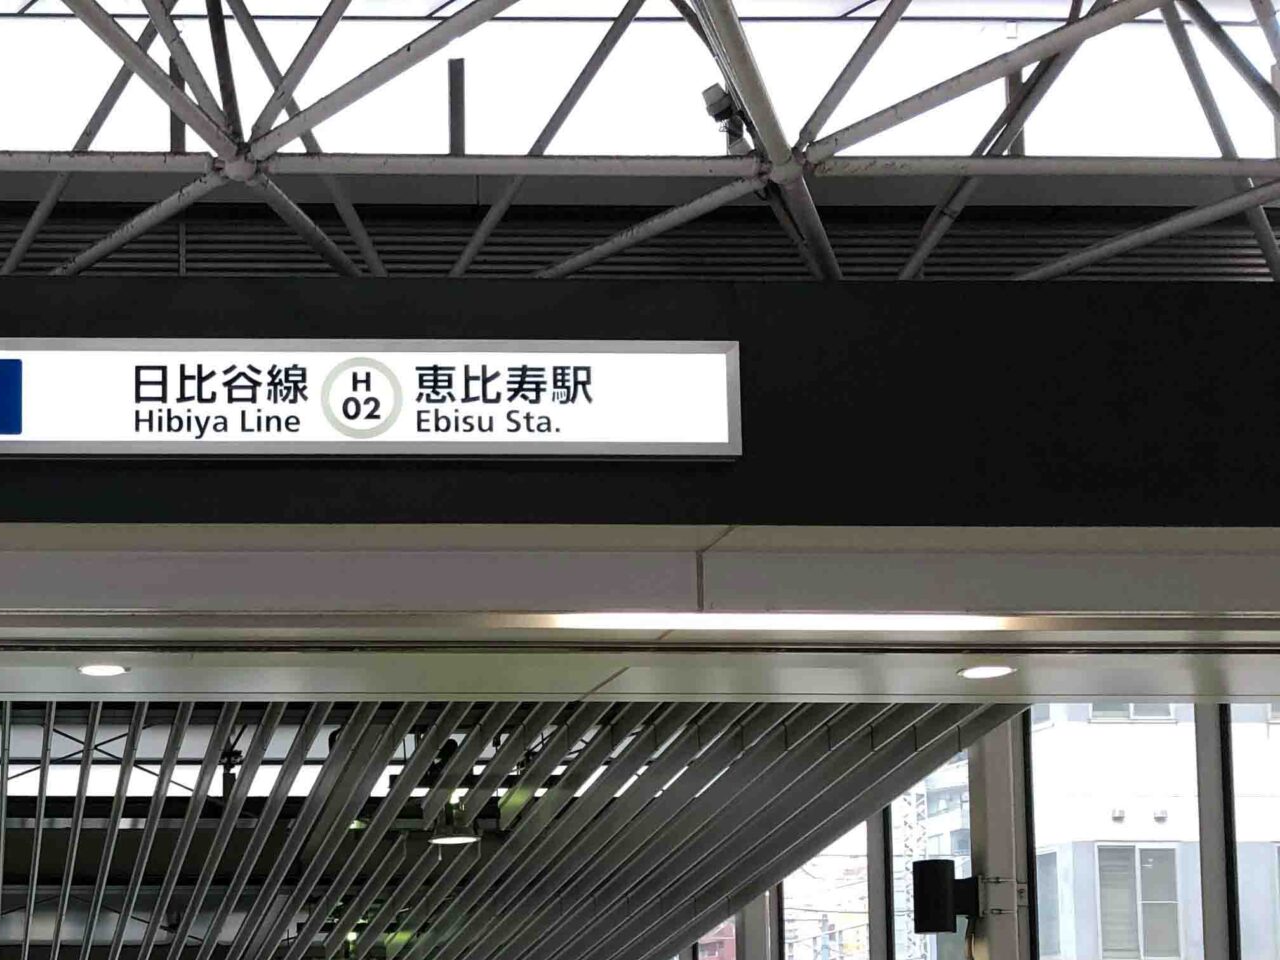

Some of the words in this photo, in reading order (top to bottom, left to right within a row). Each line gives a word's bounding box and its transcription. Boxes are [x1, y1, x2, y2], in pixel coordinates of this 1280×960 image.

[134, 363, 309, 404] 日比谷線
[352, 371, 372, 392] H
[415, 364, 593, 404] 恵比寿駅
[342, 396, 381, 420] 02
[416, 408, 494, 433] Ebisu
[506, 409, 561, 433] Sta.
[134, 408, 229, 439] Hibiya
[240, 409, 301, 433] Line
